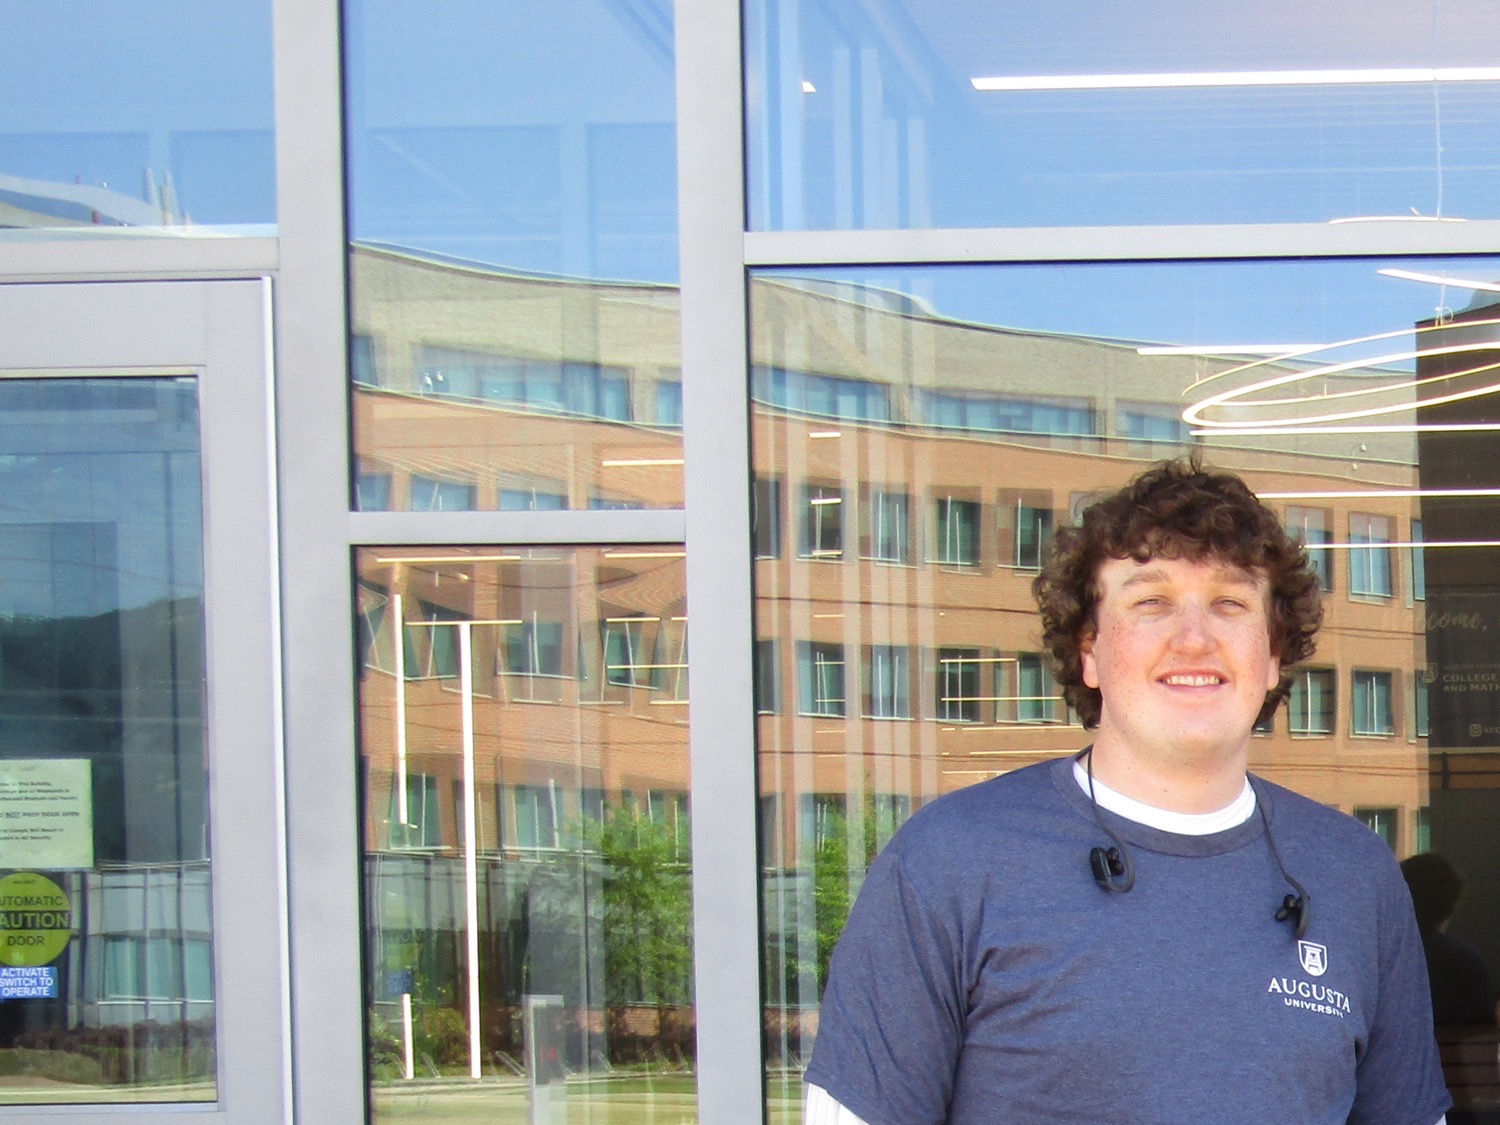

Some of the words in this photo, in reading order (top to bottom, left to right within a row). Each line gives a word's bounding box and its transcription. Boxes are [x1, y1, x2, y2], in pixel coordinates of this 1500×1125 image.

[1442, 673, 1497, 683] COLLEGE
[1443, 684, 1467, 692] AND
[0, 895, 63, 907] UTOMATIC
[0, 912, 69, 928] AUTION
[7, 935, 45, 946] DOOR
[1, 968, 49, 978] ACTIVATE
[0, 977, 37, 987] SWITCH
[39, 977, 53, 986] TO
[2, 986, 50, 997] OPERATE
[1268, 977, 1351, 1013] AUGUSTA
[1284, 997, 1344, 1018] UNIVERSITY
